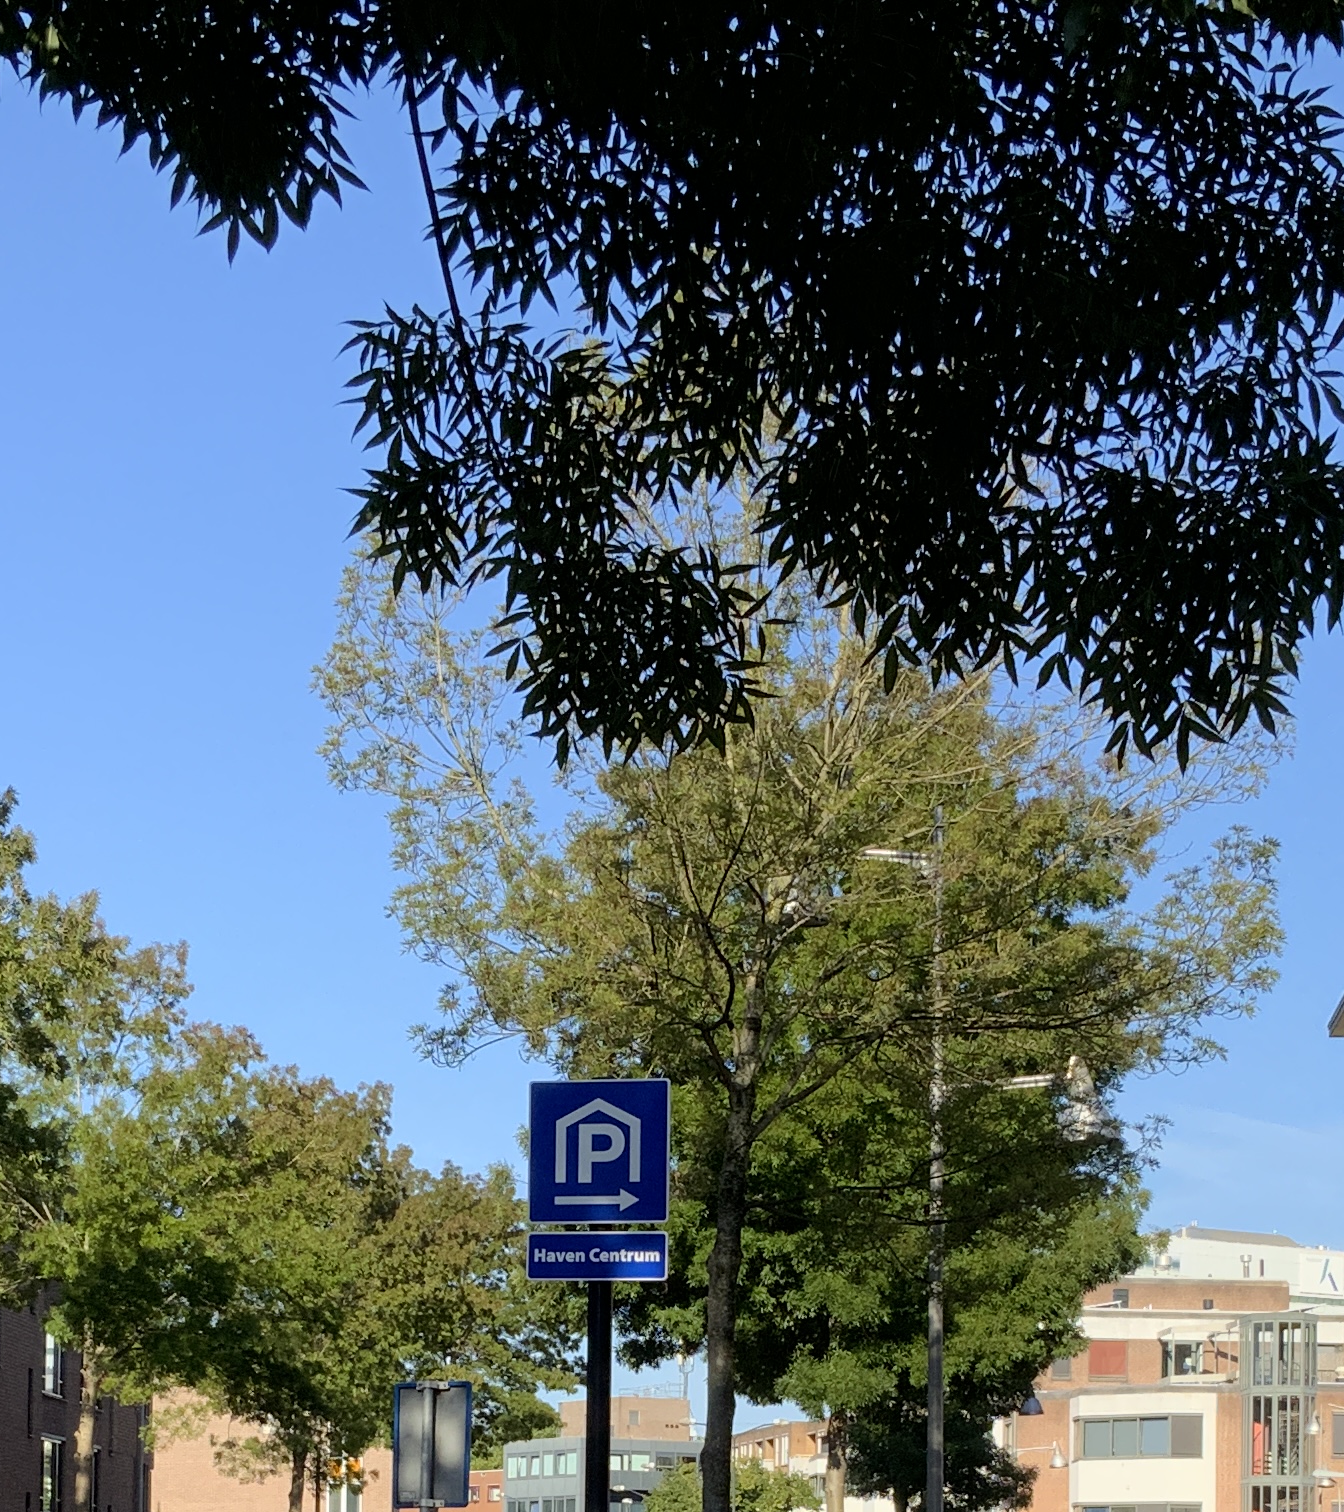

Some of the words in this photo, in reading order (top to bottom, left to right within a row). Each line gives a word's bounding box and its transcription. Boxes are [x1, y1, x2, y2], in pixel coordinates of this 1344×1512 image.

[578, 1123, 626, 1184] P
[533, 1248, 586, 1262] Haven
[588, 1248, 661, 1262] Centrum
